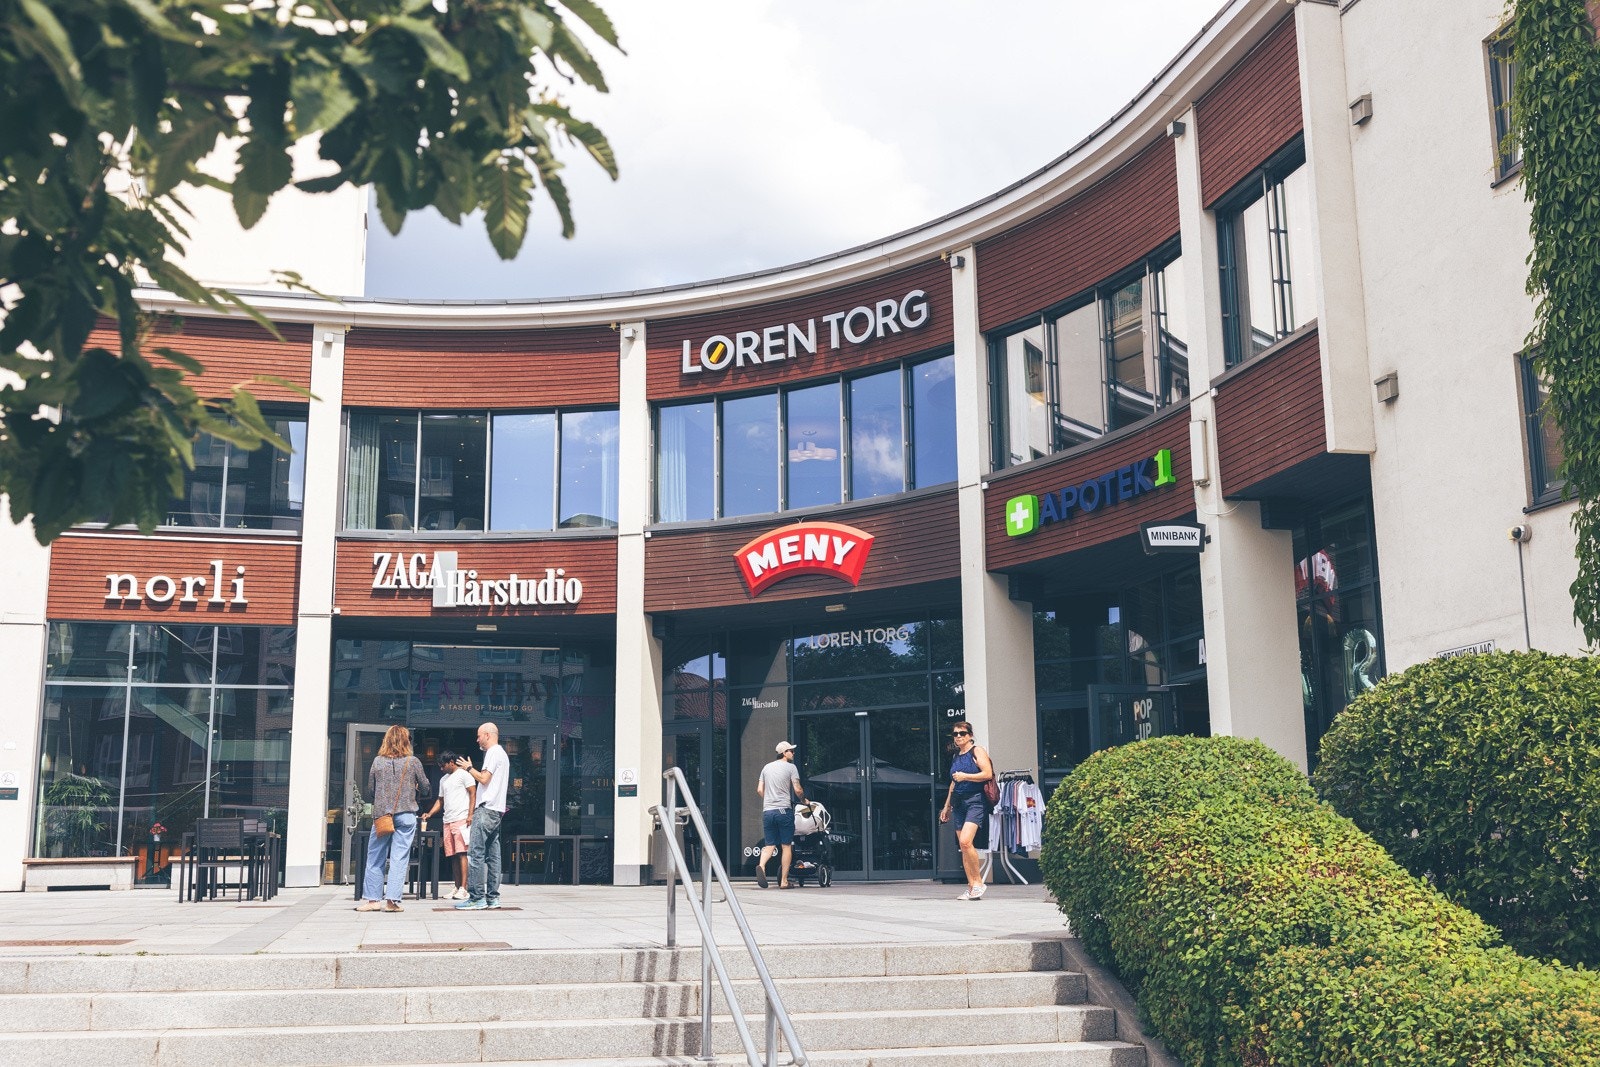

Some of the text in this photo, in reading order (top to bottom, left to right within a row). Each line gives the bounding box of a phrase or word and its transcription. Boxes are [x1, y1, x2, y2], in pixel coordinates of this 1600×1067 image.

[822, 289, 931, 350] TORG
[1151, 531, 1198, 542] MINIBANK
[371, 552, 446, 589] ZAGA
[746, 533, 857, 578] MENY
[104, 559, 249, 604] norli
[445, 568, 583, 606] Hårstudio
[864, 626, 910, 644] TORG
[508, 704, 519, 712] TO
[521, 704, 533, 712] GO
[1133, 698, 1153, 721] POP
